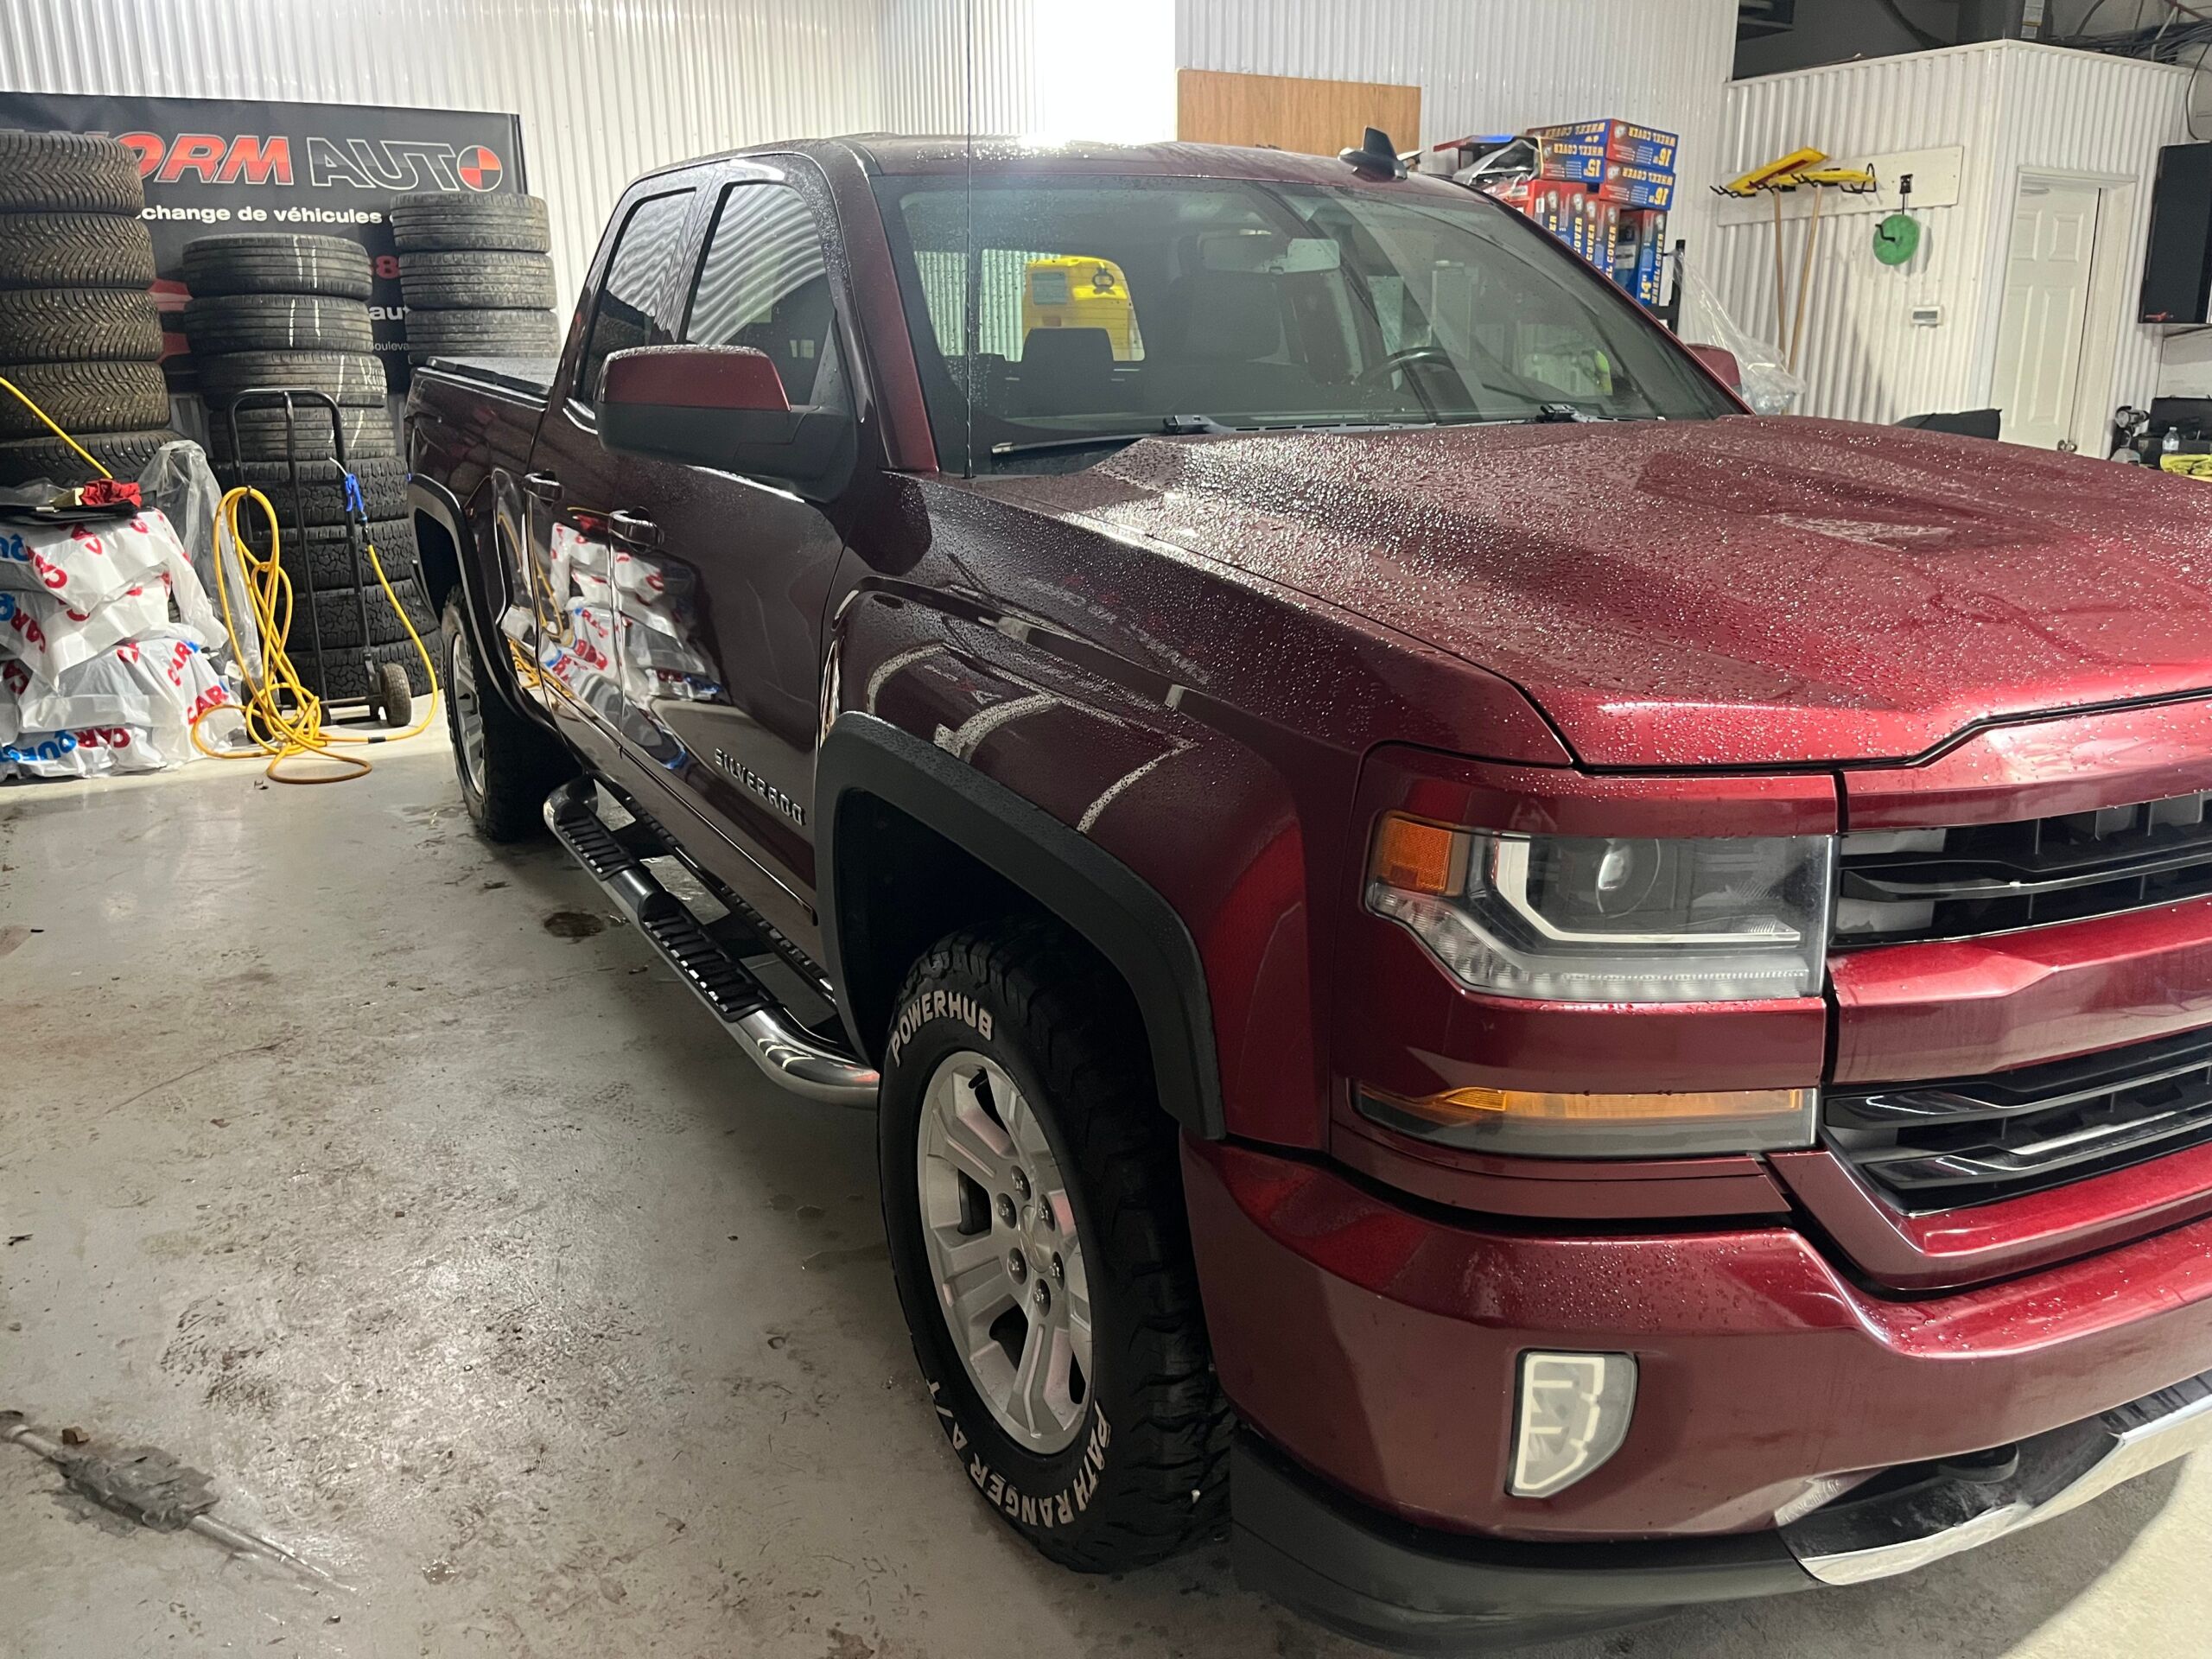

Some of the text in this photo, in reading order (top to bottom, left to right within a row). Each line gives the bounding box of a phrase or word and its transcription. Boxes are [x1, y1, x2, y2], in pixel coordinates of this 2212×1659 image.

[1554, 143, 1578, 156] COVER
[1579, 144, 1604, 156] WHEEL
[1628, 127, 1653, 142] COVER
[49, 130, 295, 185] ORM
[1622, 167, 1648, 181] COVER
[136, 205, 231, 224] change
[238, 207, 268, 221] de
[274, 207, 383, 225] véhicules
[1586, 224, 1596, 262] COVER
[1606, 226, 1618, 264] COVER
[715, 747, 806, 827] SILVERADO
[891, 989, 994, 1068] POWERHUB
[1073, 1398, 1112, 1512] PATH
[969, 1452, 1076, 1529] RANGER
